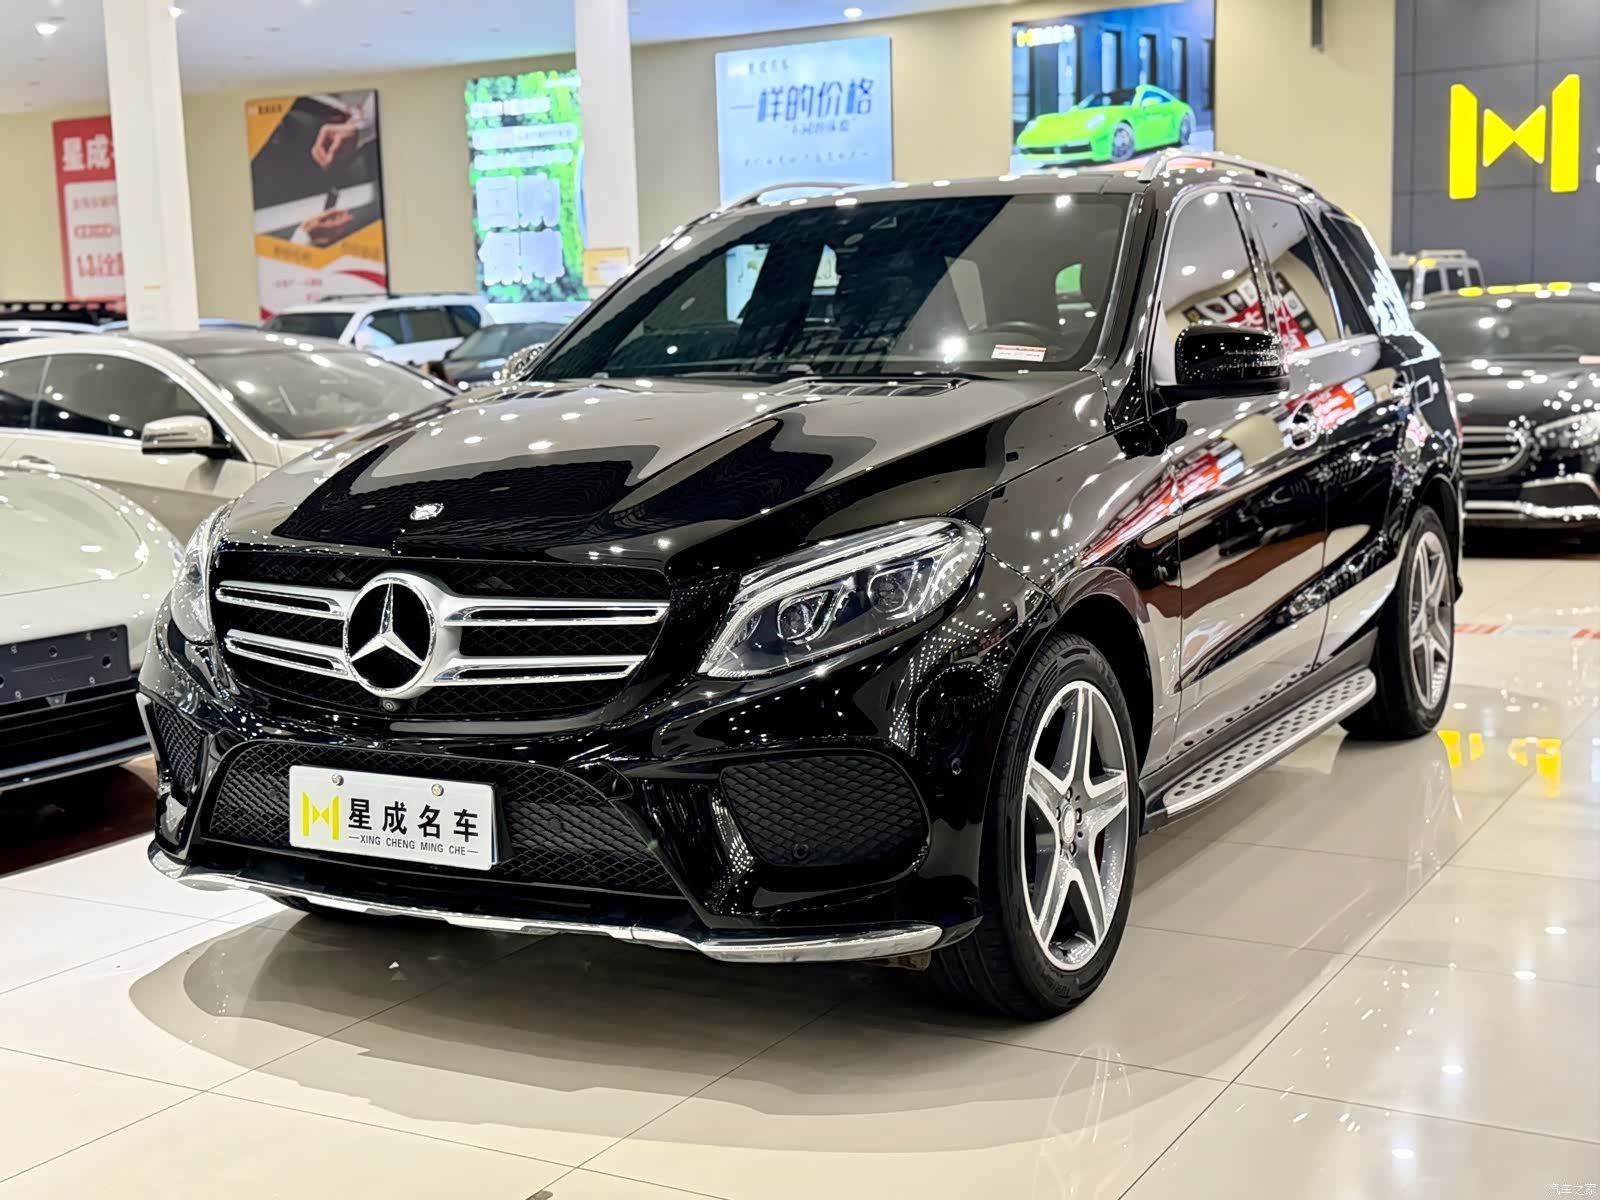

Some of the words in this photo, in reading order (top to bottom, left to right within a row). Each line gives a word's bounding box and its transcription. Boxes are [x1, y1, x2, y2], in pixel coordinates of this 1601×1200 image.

[729, 78, 874, 123] 一样的价格
[62, 133, 115, 172] 星成
[348, 797, 479, 843] 星成名车
[360, 834, 381, 846] XING
[385, 837, 415, 850] CHENG
[420, 841, 444, 853] MING
[448, 845, 466, 856] CHE
